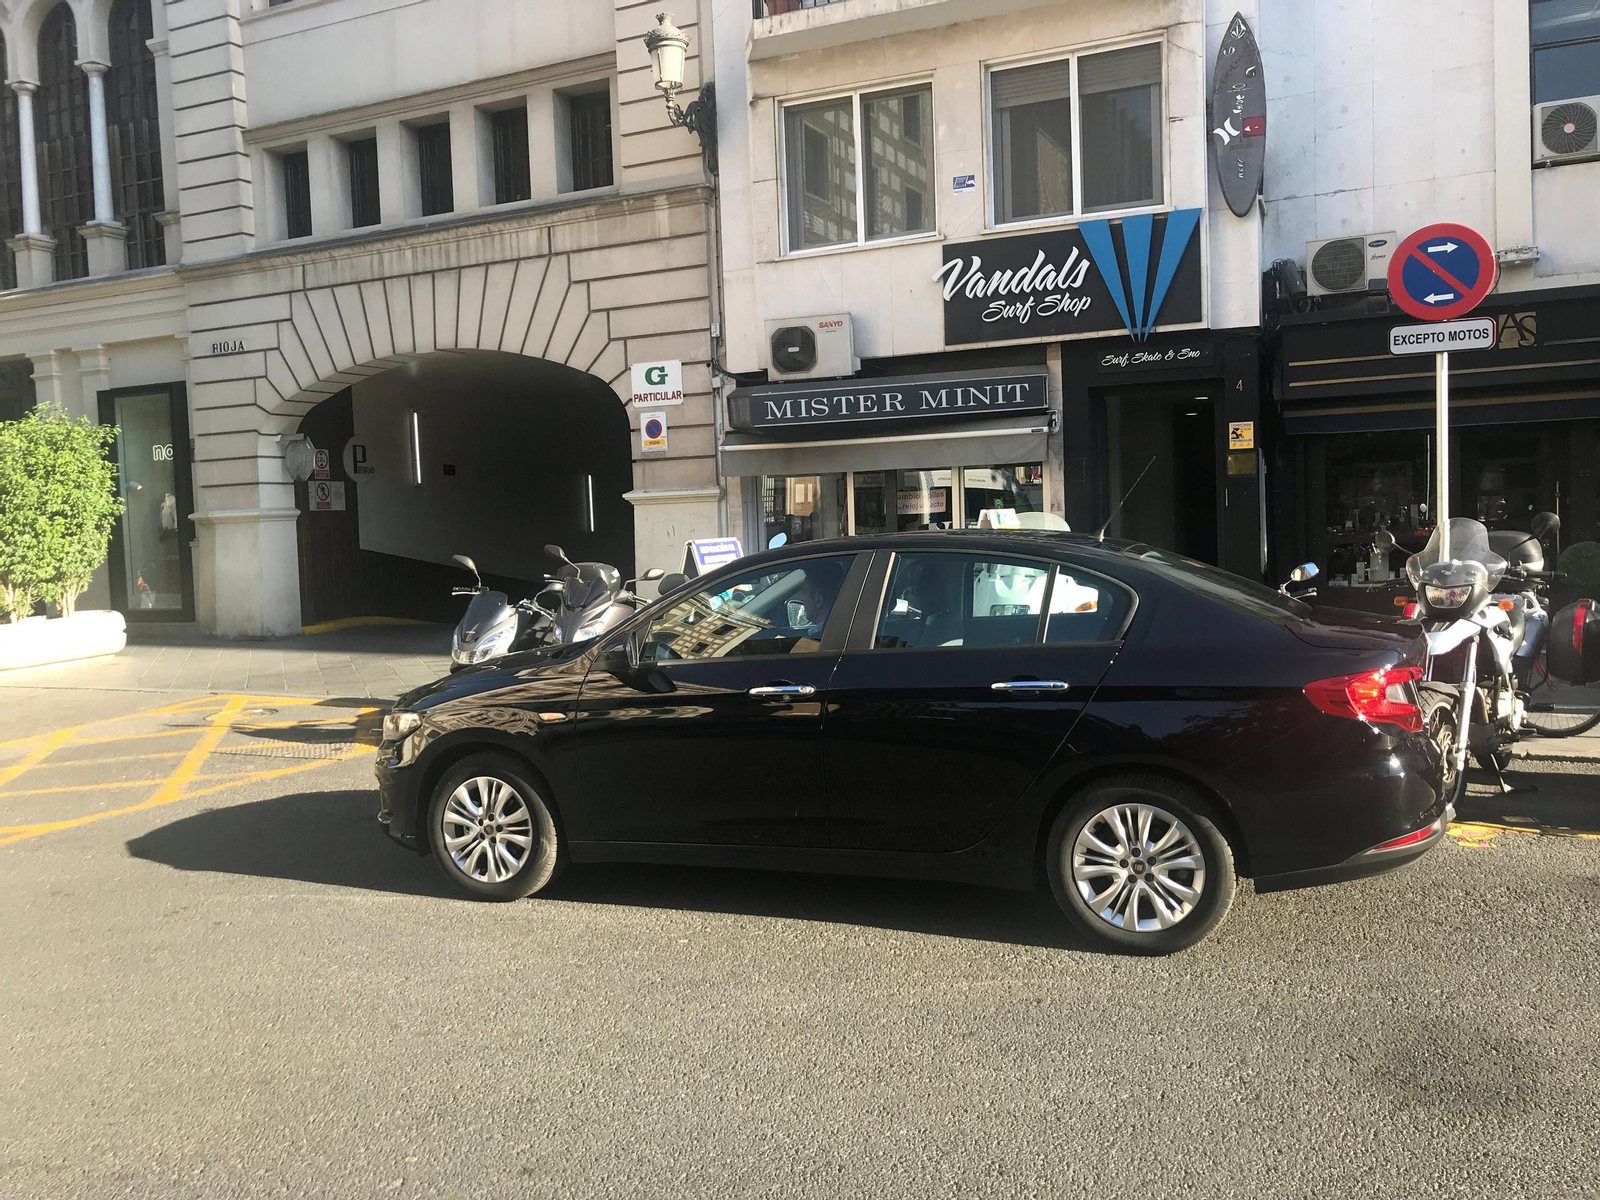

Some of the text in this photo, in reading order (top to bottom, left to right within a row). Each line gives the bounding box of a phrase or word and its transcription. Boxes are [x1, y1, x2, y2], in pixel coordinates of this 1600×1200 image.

[931, 246, 1091, 302] Vandals
[981, 292, 1091, 324] Surf Shop
[818, 320, 843, 329] SANYO
[1393, 327, 1489, 346] EXCEPTO MOTOS
[212, 340, 245, 354] RIOJA
[1164, 349, 1176, 361] &
[1176, 348, 1201, 360] Sno
[644, 366, 668, 386] G
[1235, 379, 1244, 391] 4
[633, 390, 682, 403] PARTICULAR
[763, 383, 1030, 420] MISTER MINIT
[897, 492, 920, 500] ambio
